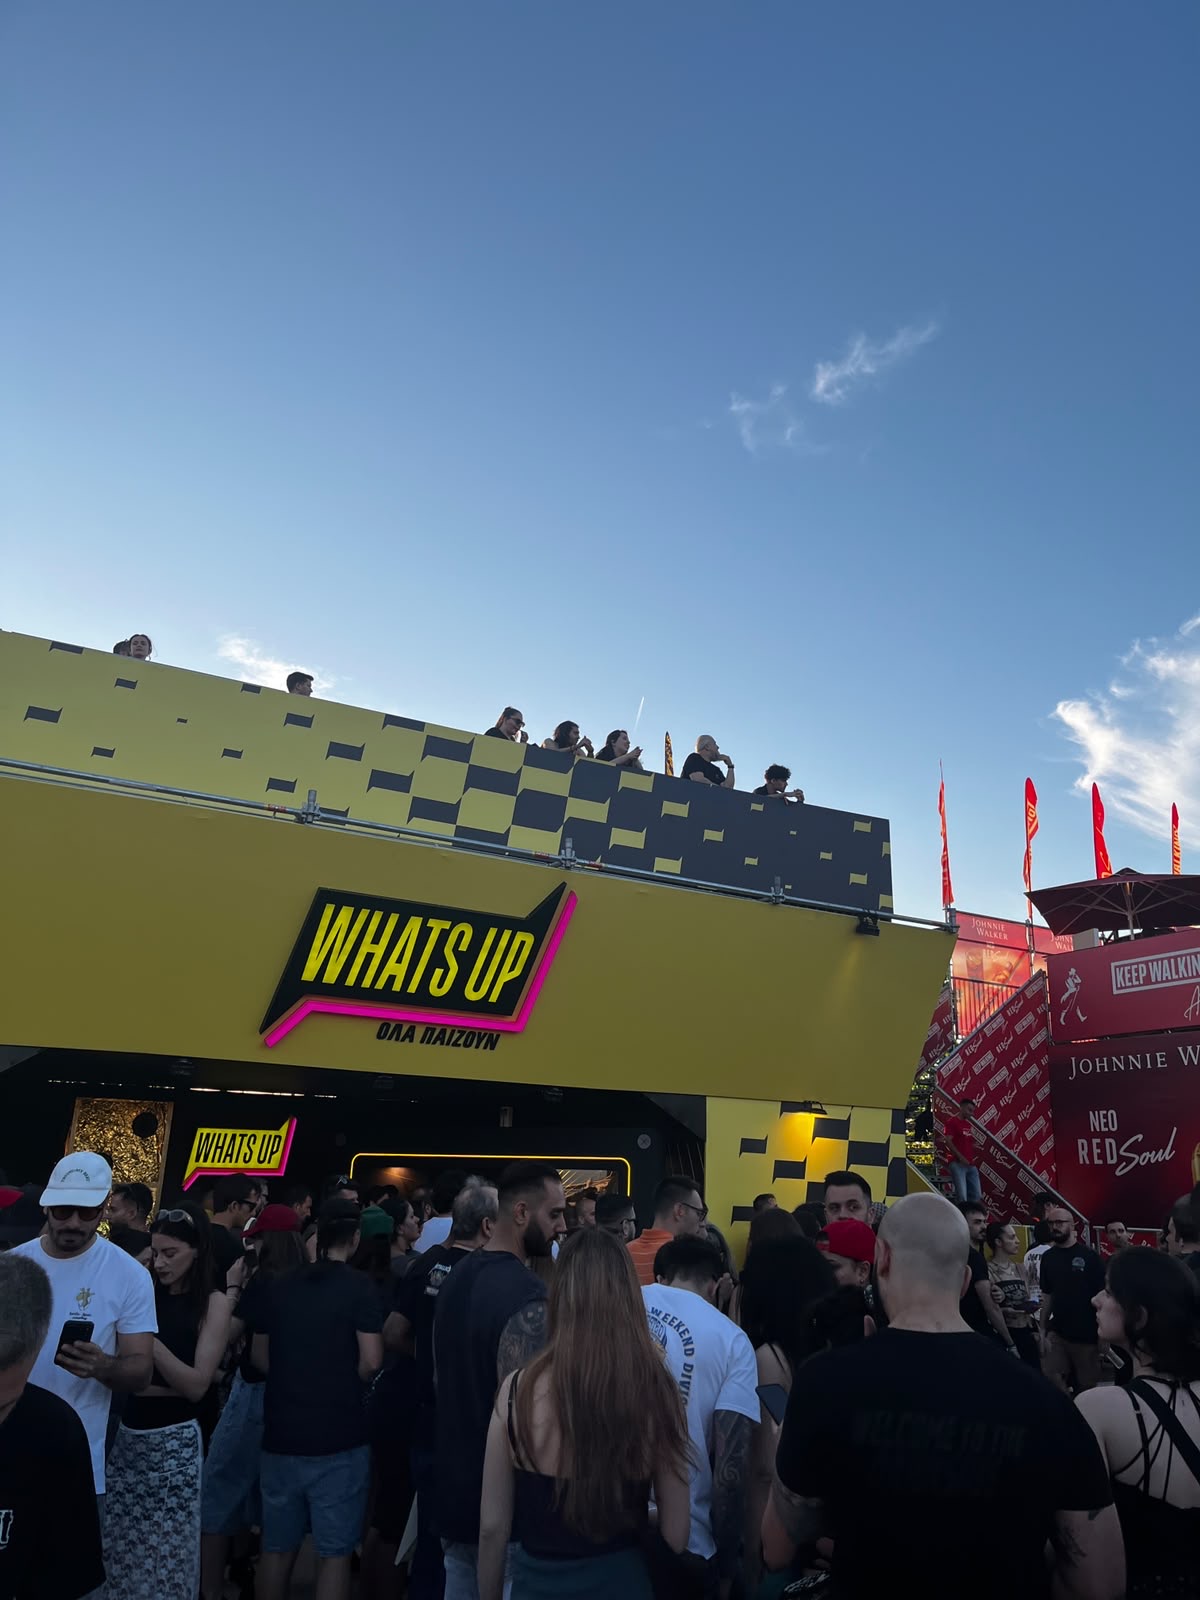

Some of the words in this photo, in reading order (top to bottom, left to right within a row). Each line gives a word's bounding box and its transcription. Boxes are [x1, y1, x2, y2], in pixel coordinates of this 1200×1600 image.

[972, 918, 1006, 930] JOHNNIE
[976, 927, 1009, 940] WALKER
[301, 903, 473, 997] WHATS
[464, 927, 535, 1003] UP
[1116, 964, 1147, 988] KEEP
[420, 1026, 500, 1051] ΠΑΙΖΟΥΝ
[1069, 1052, 1168, 1080] JOHNNIE
[1089, 1109, 1118, 1132] NEO
[195, 1132, 257, 1164] WHATS
[257, 1134, 282, 1164] UP
[1077, 1138, 1118, 1165] RED
[1115, 1126, 1177, 1176] Soul
[651, 1306, 695, 1357] WEEKEND
